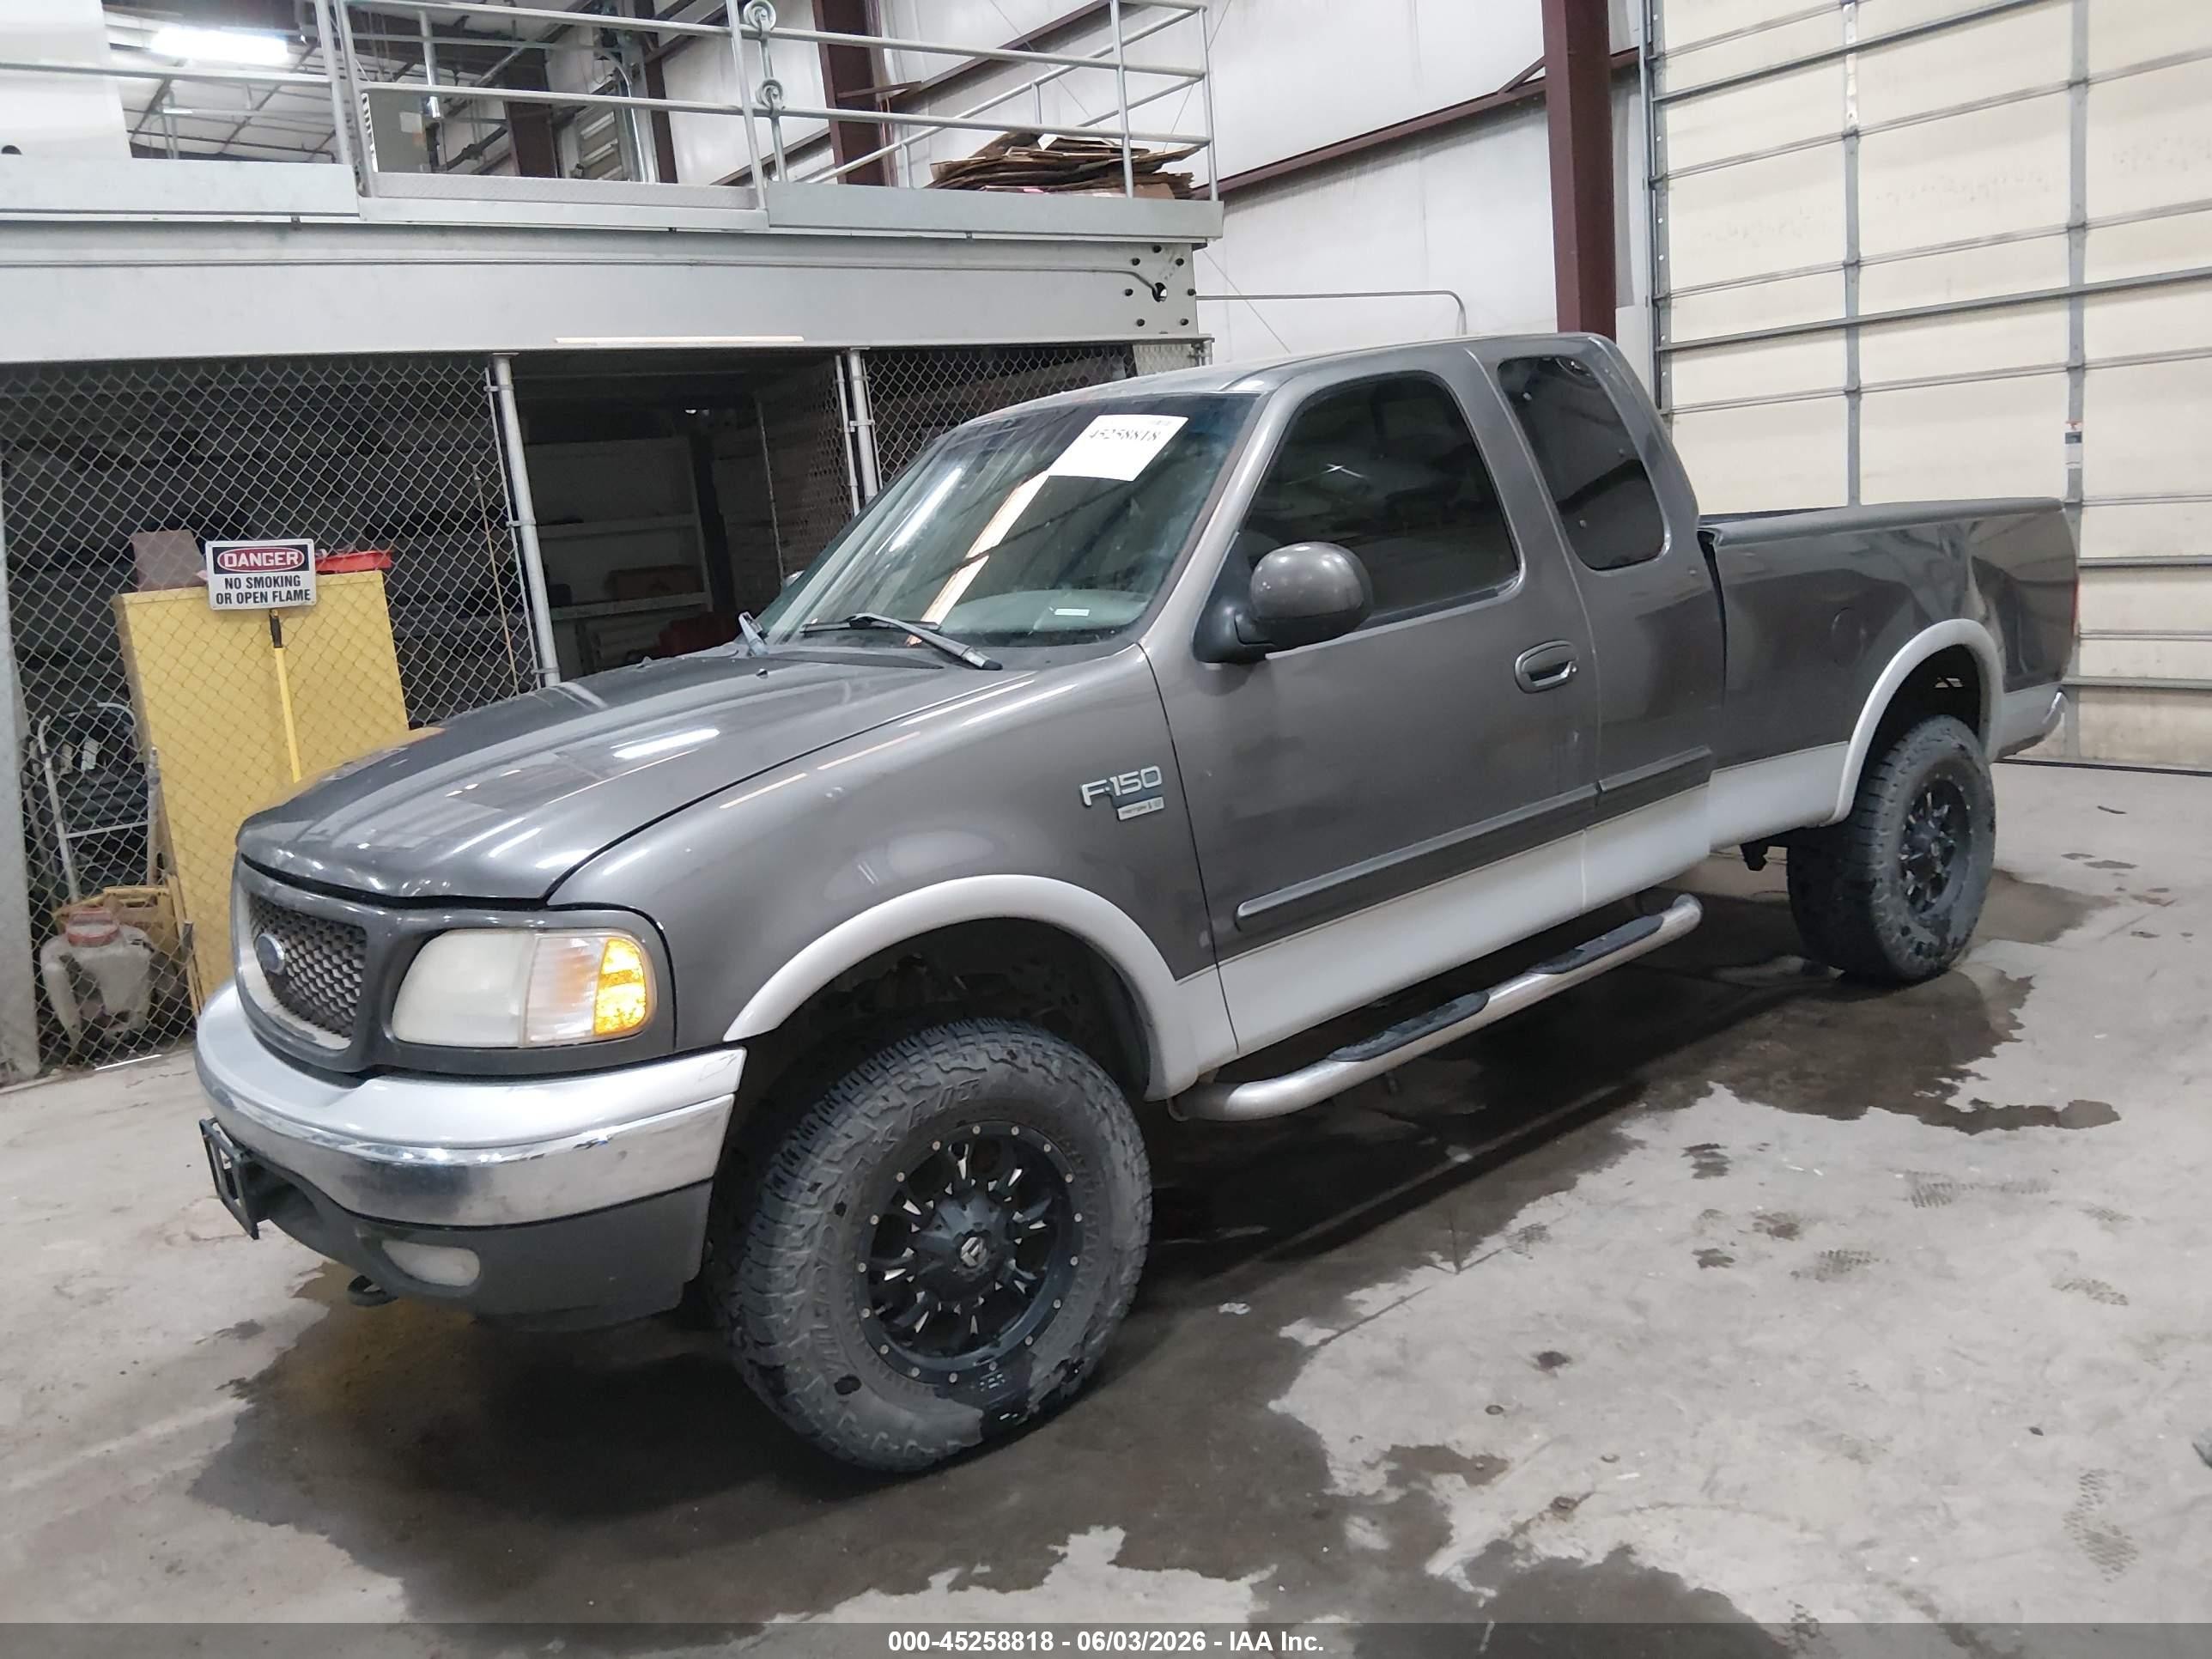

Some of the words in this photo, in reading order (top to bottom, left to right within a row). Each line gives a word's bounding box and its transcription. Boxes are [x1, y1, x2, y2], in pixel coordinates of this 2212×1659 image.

[224, 551, 299, 567] DANGER
[224, 577, 242, 589] NO
[246, 574, 301, 589] SMOKING
[216, 592, 233, 605] OR
[236, 591, 268, 604] OPEN
[272, 589, 311, 602] FLAME
